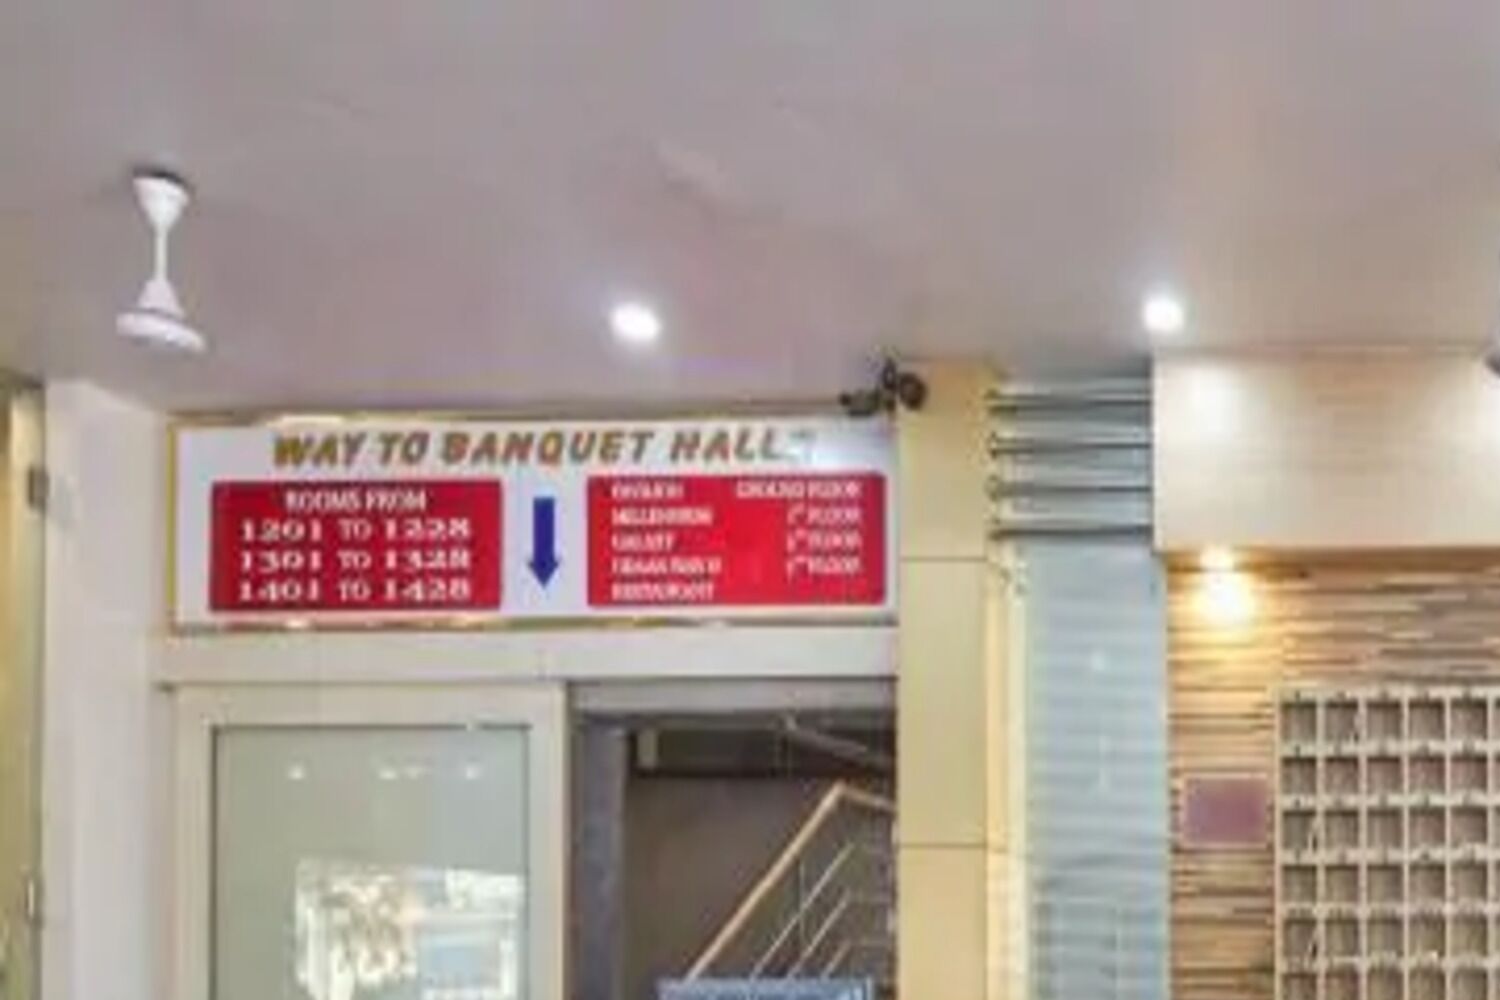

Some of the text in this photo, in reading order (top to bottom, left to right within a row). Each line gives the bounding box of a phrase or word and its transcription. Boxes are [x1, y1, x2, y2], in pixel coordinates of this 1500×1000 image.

[272, 427, 816, 470] WAY TO BANQUET HALL
[285, 489, 427, 513] ROOMS FROM
[241, 517, 470, 542] 1201 TO 1228
[241, 550, 322, 573] 1301
[337, 549, 372, 571] TO
[239, 578, 470, 602] 1401 TO 1428
